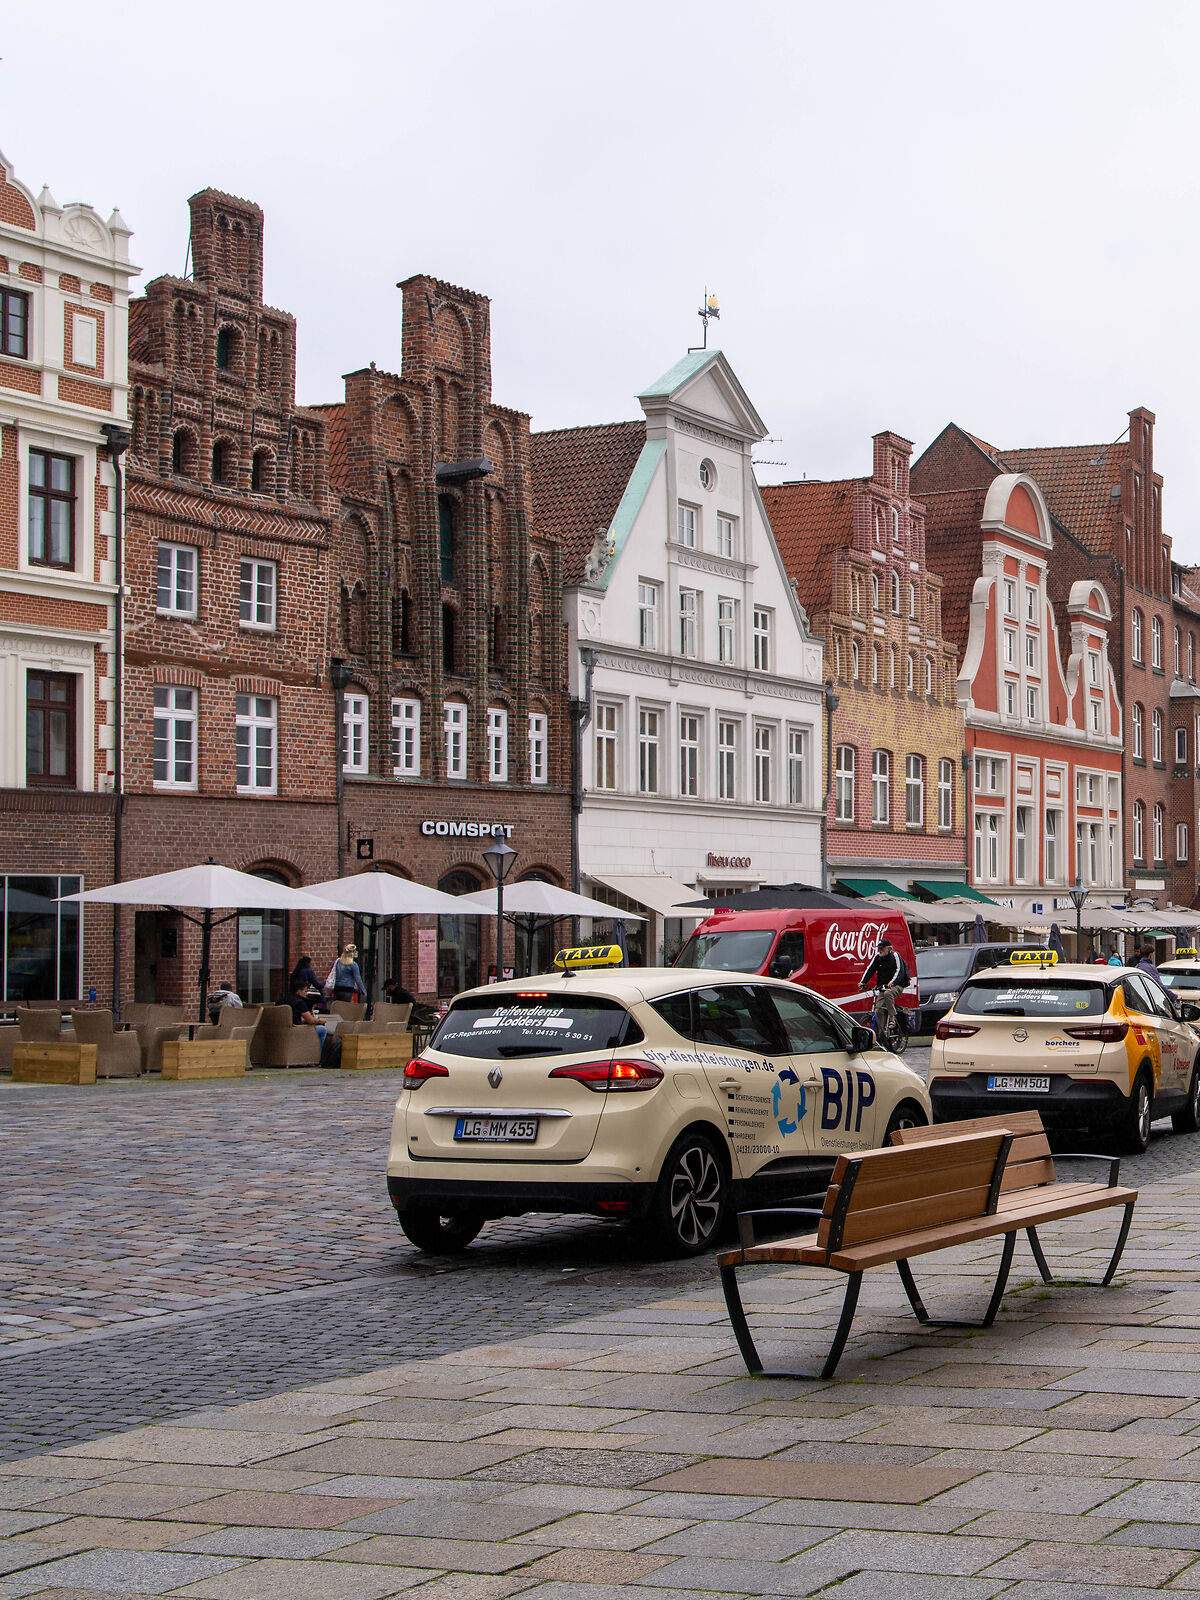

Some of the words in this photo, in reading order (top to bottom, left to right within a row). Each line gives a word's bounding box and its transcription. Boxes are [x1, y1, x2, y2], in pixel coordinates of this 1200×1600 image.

[422, 821, 515, 839] COMSPOT
[730, 856, 751, 868] coco
[825, 922, 889, 961] Coca-Col
[564, 947, 605, 960] TAXI
[1017, 952, 1048, 960] TAXI
[492, 1005, 564, 1017] Reifendienst
[499, 1016, 545, 1027] Lodders
[443, 1028, 502, 1040] KFZ-Reparaturen
[521, 1028, 534, 1036] Tel.
[535, 1029, 558, 1037] 04131
[643, 1050, 775, 1073] bip-dienstleistungen.de
[994, 1077, 1008, 1088] LG
[1013, 1077, 1027, 1088] MM
[1029, 1077, 1049, 1089] 501
[820, 1066, 876, 1133] BIP
[463, 1121, 482, 1136] LG
[489, 1121, 508, 1137] MM
[509, 1122, 535, 1137] 455
[820, 1136, 859, 1152] Dienstleistungen
